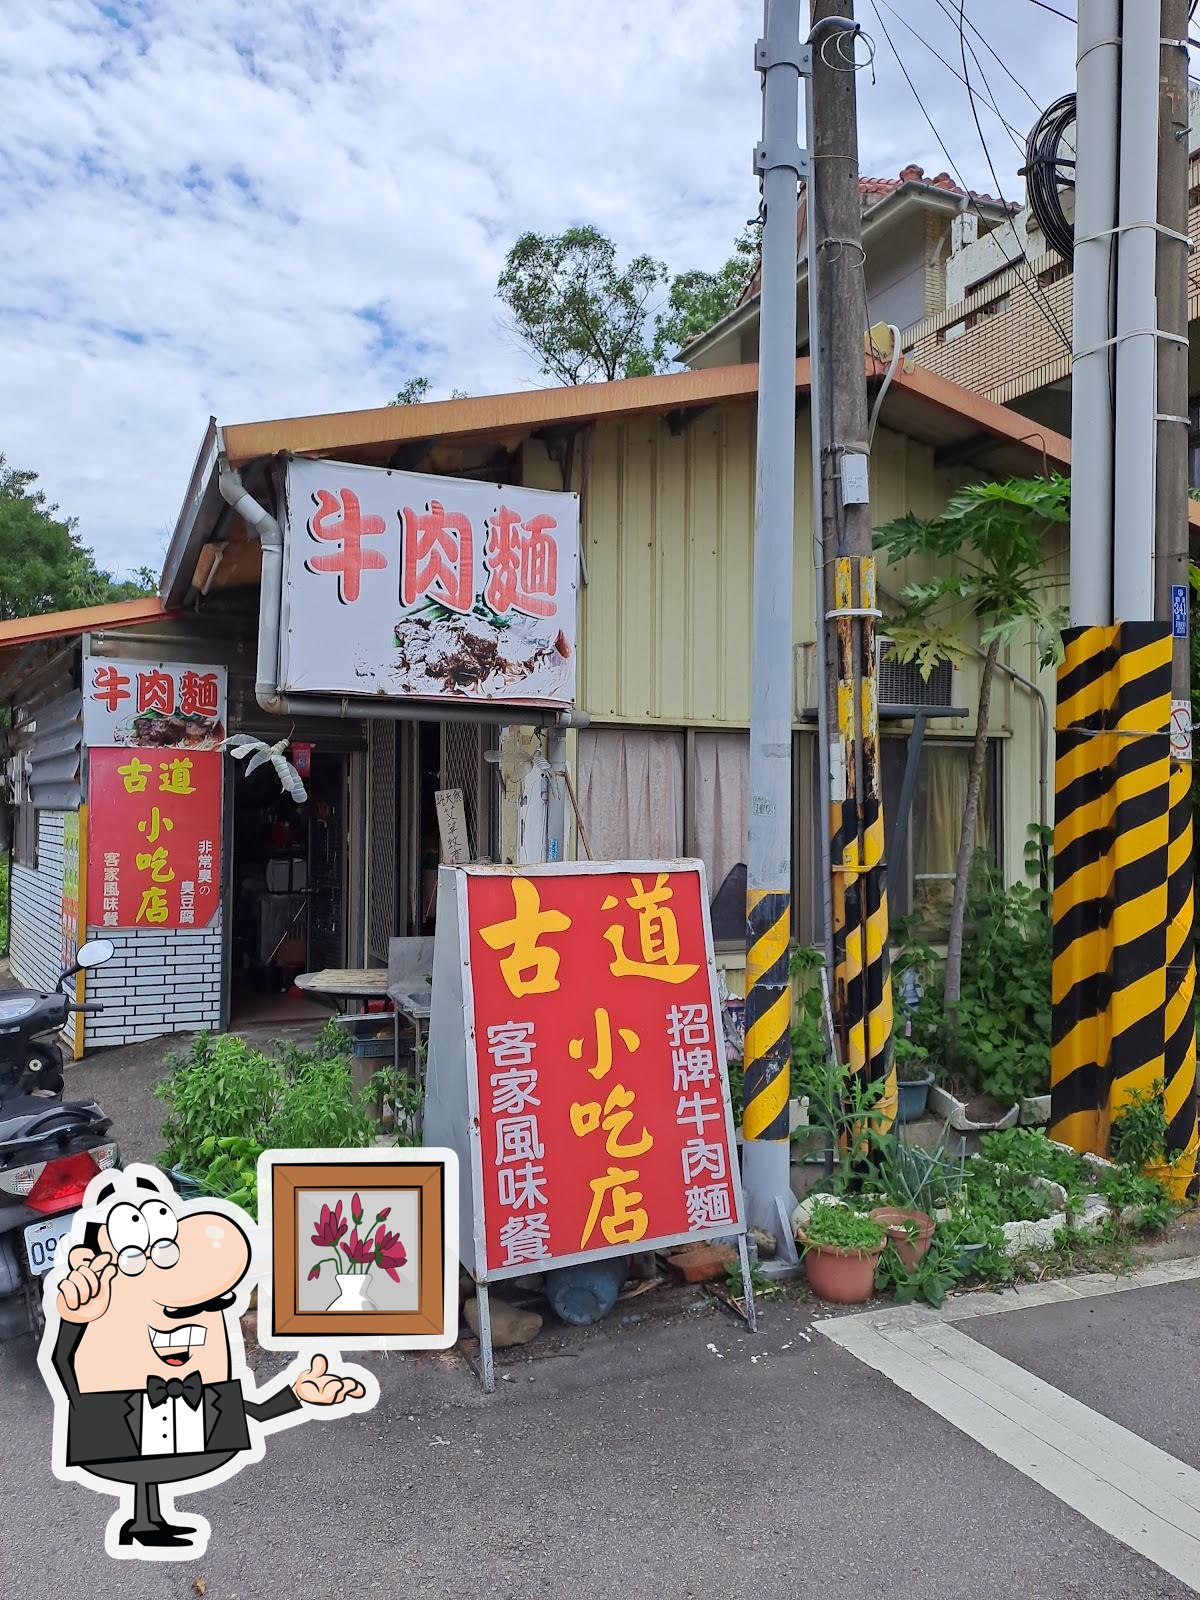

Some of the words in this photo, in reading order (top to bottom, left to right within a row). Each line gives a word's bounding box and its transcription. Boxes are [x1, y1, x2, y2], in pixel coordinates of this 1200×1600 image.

[304, 488, 558, 618] 牛肉麵
[92, 665, 218, 717] 牛肉麵
[117, 756, 197, 795] 古道
[103, 851, 121, 927] 客家風味餐
[135, 806, 176, 924] 小吃店
[179, 879, 195, 925] 臭豆腐
[478, 871, 701, 999] 古道
[486, 1020, 554, 1267] 客家風味餐
[568, 1007, 655, 1250] 小吃店
[666, 1002, 734, 1232] 招牌牛肉麵
